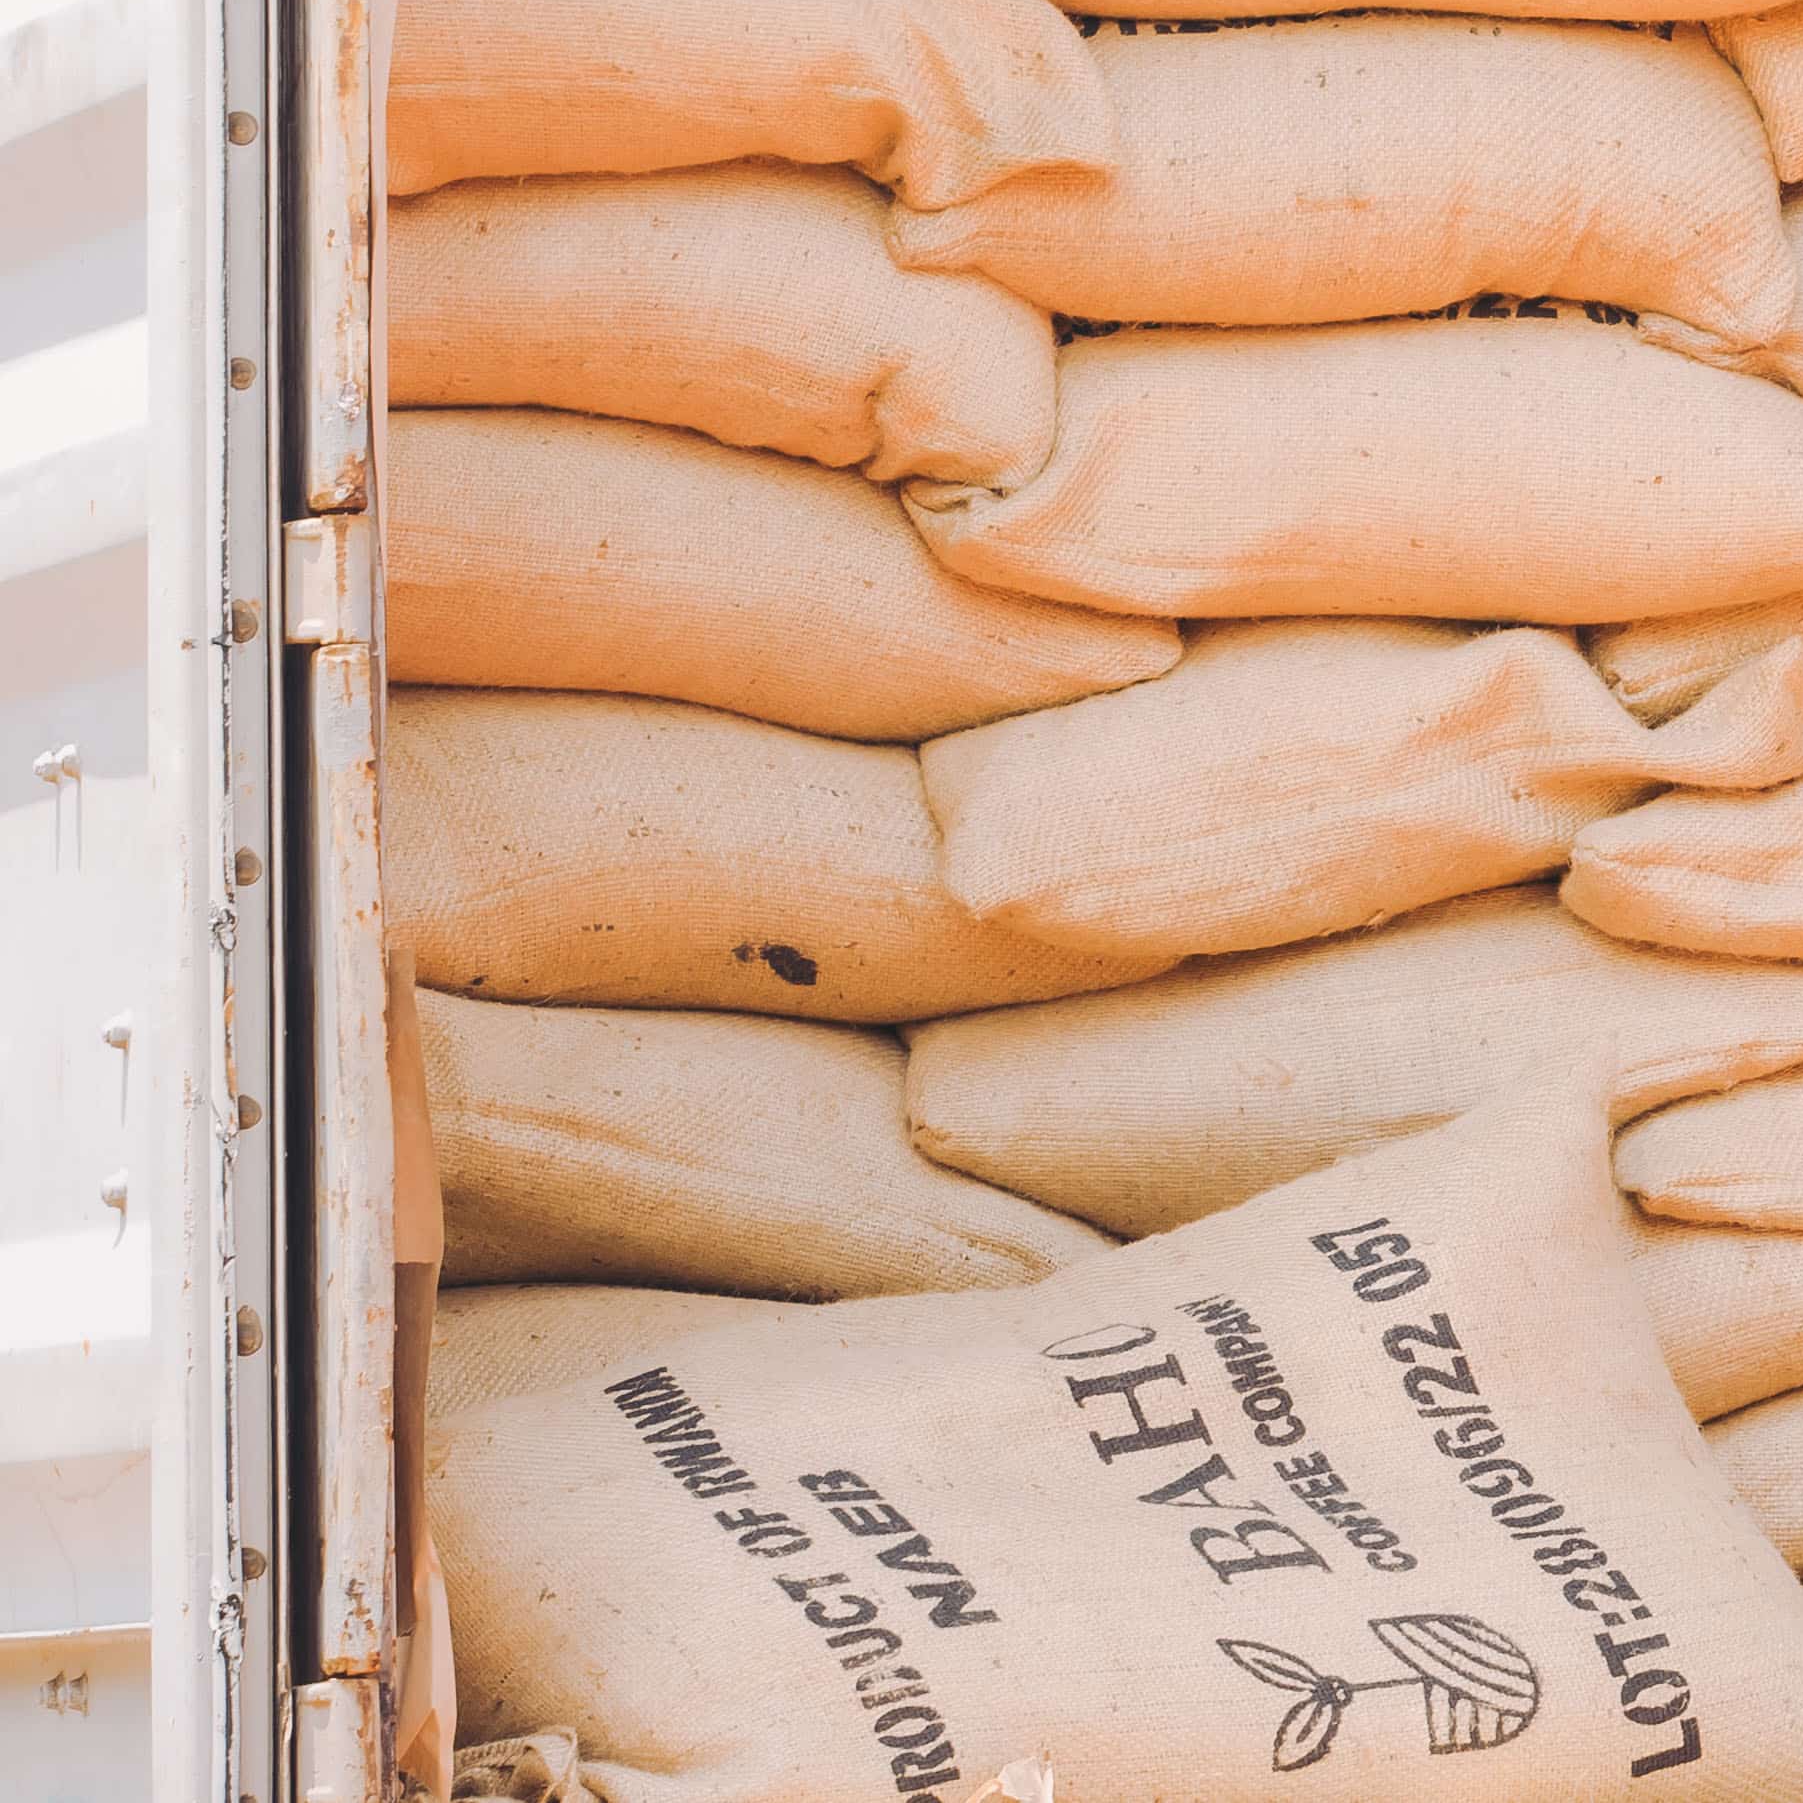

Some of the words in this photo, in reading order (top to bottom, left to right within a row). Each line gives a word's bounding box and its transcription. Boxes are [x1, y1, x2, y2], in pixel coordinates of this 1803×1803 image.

[1308, 1216, 1434, 1304] 057
[1173, 1293, 1308, 1448] COMPANY
[713, 1507, 813, 1560] OF
[1040, 1323, 1334, 1586] BAHO
[1272, 1449, 1419, 1574] COFFEE
[797, 1468, 1001, 1629] NAEB
[1381, 1311, 1703, 1779] LOT:28/096/22
[773, 1571, 962, 1803] RODUCT
